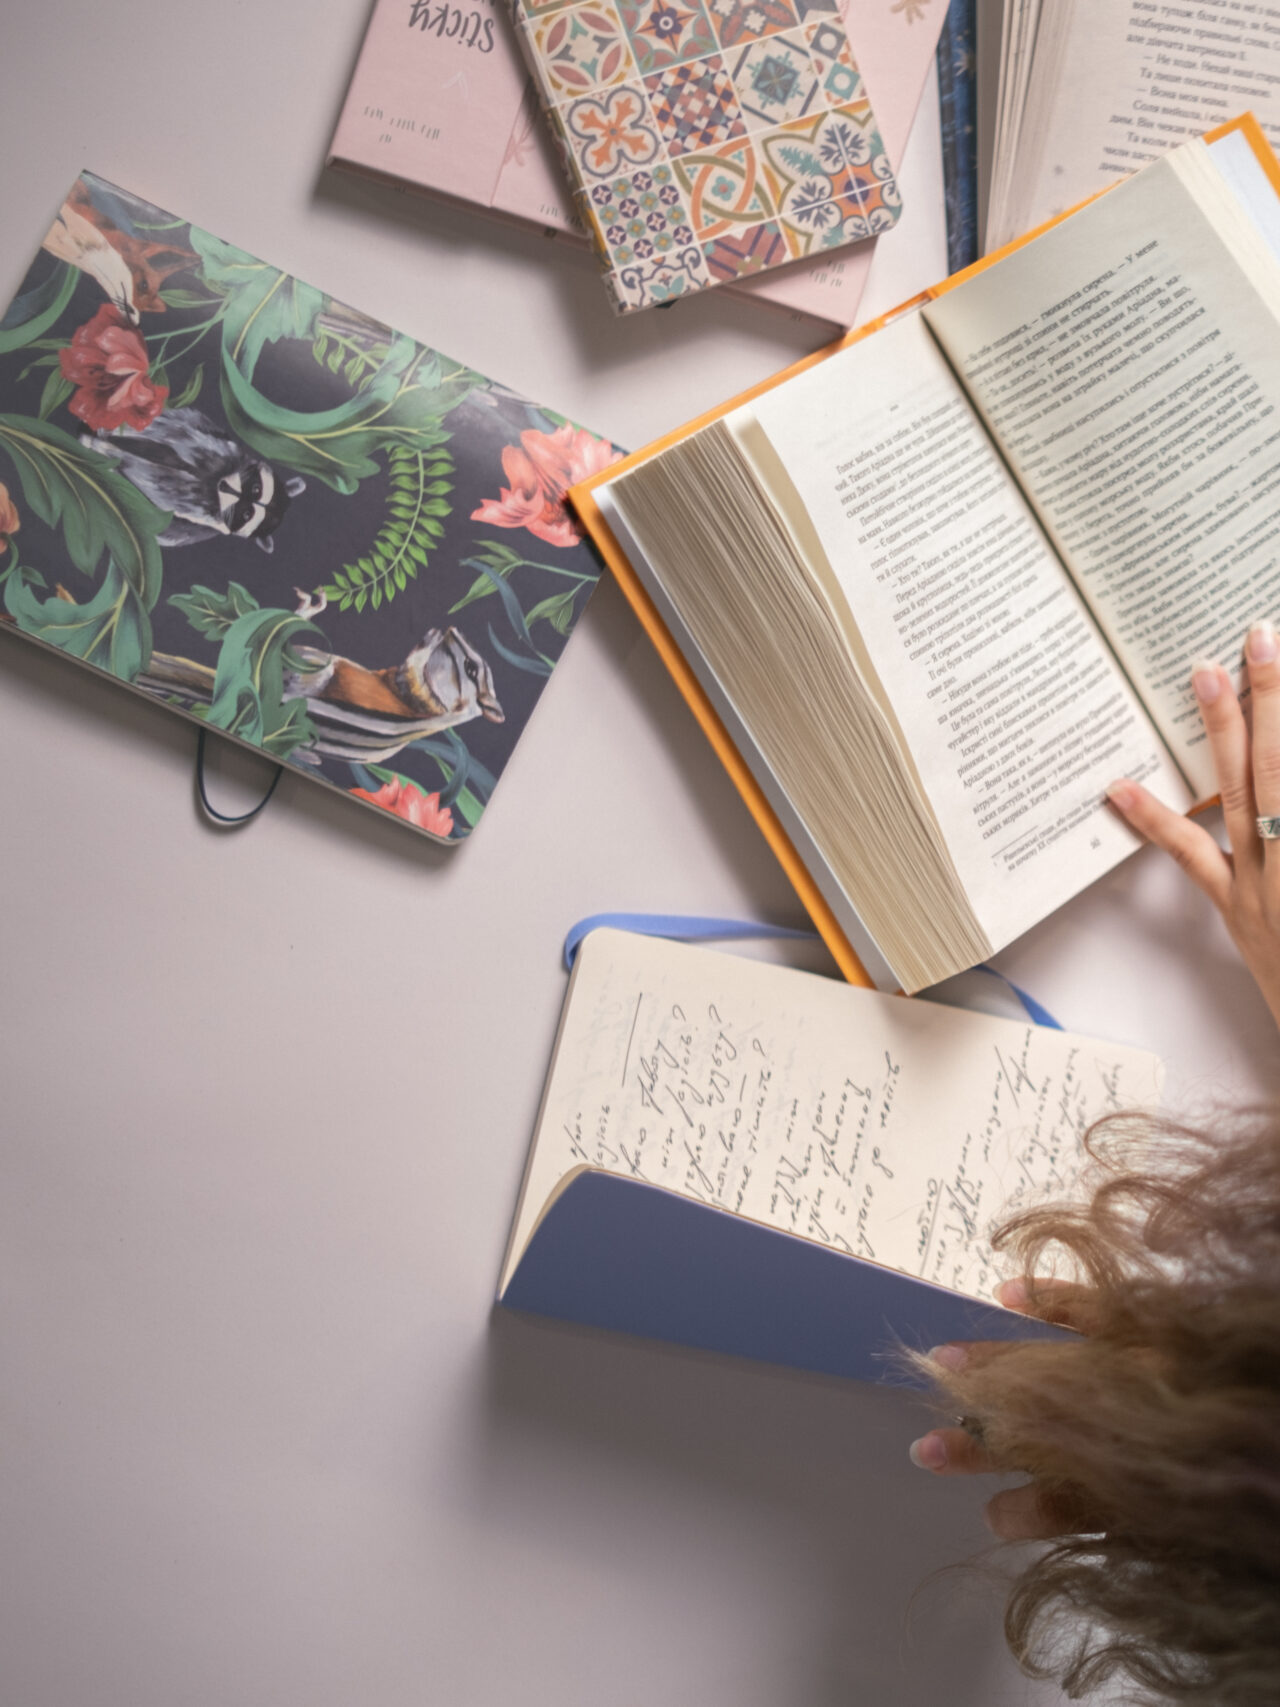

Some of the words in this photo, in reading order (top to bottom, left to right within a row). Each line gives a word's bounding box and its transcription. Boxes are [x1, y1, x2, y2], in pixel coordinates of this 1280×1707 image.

[407, 0, 495, 53] Sticky
[1140, 66, 1153, 80] Та
[1040, 291, 1082, 321] гмикнула
[1081, 269, 1116, 294] сирена.
[1124, 254, 1133, 264] У
[1134, 239, 1159, 259] мене
[1056, 331, 1070, 343] не
[1068, 305, 1111, 335] змовчала
[1110, 275, 1157, 308] повітруля.
[1058, 313, 1071, 325] не
[1070, 289, 1112, 318] стирчать.
[1046, 340, 1082, 366] розвела
[1079, 333, 1093, 343] їх
[1091, 311, 1126, 338] руками
[1126, 287, 1166, 314] Аріадна,
[1164, 274, 1181, 288] ма-
[1054, 359, 1075, 377] воду
[1082, 330, 1122, 359] вузького
[1121, 315, 1146, 333] молу.
[1156, 296, 1173, 310] Ви
[1172, 285, 1192, 300] що,
[1077, 346, 1123, 378] потерчата
[1122, 326, 1152, 348] чемно
[1151, 297, 1196, 330] поводять-
[1041, 400, 1062, 416] вона
[1060, 393, 1074, 404] на
[1072, 372, 1107, 397] зграйку
[1106, 352, 1141, 376] малечі,
[1139, 341, 1156, 355] що
[1154, 306, 1206, 344] скупчилася
[1074, 394, 1125, 428] насупились
[1128, 356, 1180, 394] опустилися
[1185, 328, 1221, 356] повітря
[1077, 450, 1114, 473] Аріадна,
[1111, 425, 1150, 453] хитаючи
[1149, 401, 1190, 429] головою,
[1188, 385, 1210, 403] ніби
[1208, 363, 1242, 388] намага-
[1097, 430, 1117, 445] Хто
[1114, 420, 1133, 435] там
[1146, 397, 1167, 415] хоче
[1166, 363, 1214, 401] зустрітися?
[1101, 465, 1138, 490] посеред
[1136, 451, 1159, 469] молу
[1158, 414, 1217, 456] розхристана,
[1215, 396, 1238, 417] край
[1236, 381, 1260, 401] шалі
[835, 459, 856, 475] Голос
[1141, 469, 1181, 498] прийняв
[1180, 460, 1195, 472] би
[1205, 417, 1260, 455] божевільну,
[1259, 404, 1275, 419] що
[1110, 521, 1151, 547] чарівник.
[1150, 491, 1194, 523] Могутній
[1194, 464, 1239, 494] чарівник,
[1120, 532, 1182, 573] африканським
[1181, 510, 1218, 535] іменем,
[1215, 489, 1240, 512] бува?
[1154, 555, 1170, 569] але
[1170, 534, 1203, 558] сирена
[1203, 501, 1250, 537] здивовано
[897, 573, 912, 586] Хто
[909, 564, 922, 579] ти?
[1150, 599, 1174, 616] Якби
[1173, 571, 1218, 603] повітруля
[1230, 527, 1280, 565] підтримала
[1157, 569, 1198, 598] замовкла
[1209, 544, 1236, 564] якось
[930, 652, 939, 664] Я
[937, 640, 962, 660] сирена.
[947, 681, 972, 702] Нікуди
[970, 671, 988, 687] вона
[990, 656, 1012, 673] тобою
[1010, 650, 1020, 661] не
[946, 724, 980, 750] чугайстер
[982, 714, 996, 727] яку
[994, 698, 1021, 719] віддали
[950, 720, 961, 732] Це
[959, 711, 977, 726] була
[974, 705, 984, 716] та
[982, 695, 1000, 711] сама
[996, 791, 1027, 815] пастухів,
[1029, 776, 1047, 792] вона
[1001, 804, 1030, 826] моряків.
[1029, 789, 1051, 808] Хитре
[1049, 783, 1060, 793] та
